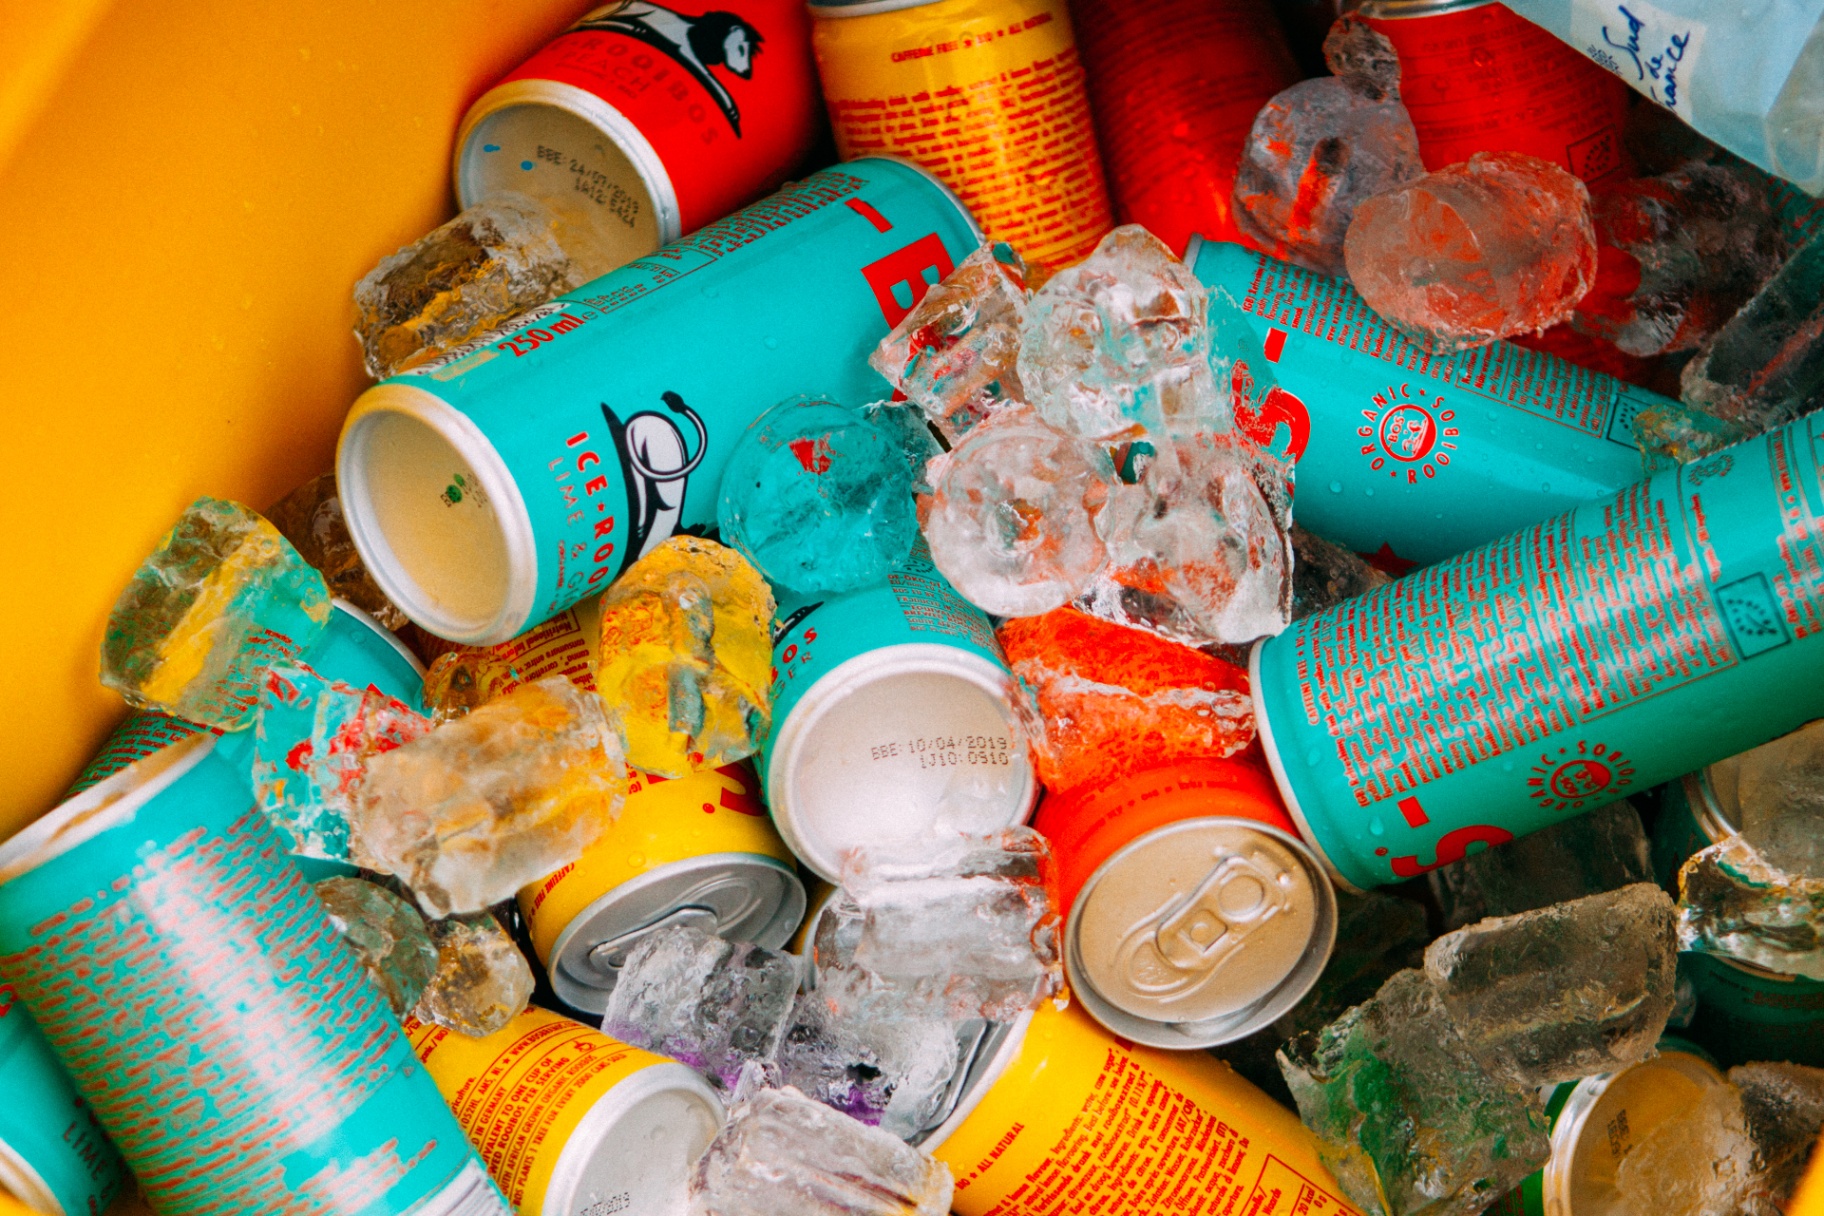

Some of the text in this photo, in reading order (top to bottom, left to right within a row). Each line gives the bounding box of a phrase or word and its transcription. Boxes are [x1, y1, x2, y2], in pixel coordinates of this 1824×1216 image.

[1602, 5, 1645, 80] Sud
[1644, 54, 1664, 79] de
[497, 311, 586, 358] 250 ml
[1387, 414, 1406, 443] BOS
[548, 456, 585, 527] LIME
[1299, 681, 1320, 725] CAFFEINE
[871, 742, 903, 761] BBE:
[477, 1078, 493, 1095] AMS,
[479, 1086, 505, 1124] GERMANY
[492, 1105, 524, 1149] ROOIBOS
[521, 1087, 538, 1103] PER
[535, 1056, 570, 1085] SERVING
[500, 1103, 514, 1116] TO
[510, 1084, 527, 1102] ONE
[524, 1067, 541, 1083] CUP
[540, 1057, 552, 1067] OF
[501, 1134, 526, 1170] AFRICAN
[521, 1104, 543, 1133] GROWN
[510, 1155, 534, 1186] PLANTS
[532, 1127, 548, 1145] TREE
[543, 1109, 558, 1125] FOR
[977, 1158, 994, 1173] ALL
[988, 1121, 1025, 1161] NATURAL
[1070, 1150, 1091, 1173] drank
[1090, 1131, 1104, 1148] met
[1127, 1188, 1146, 1208] Boire
